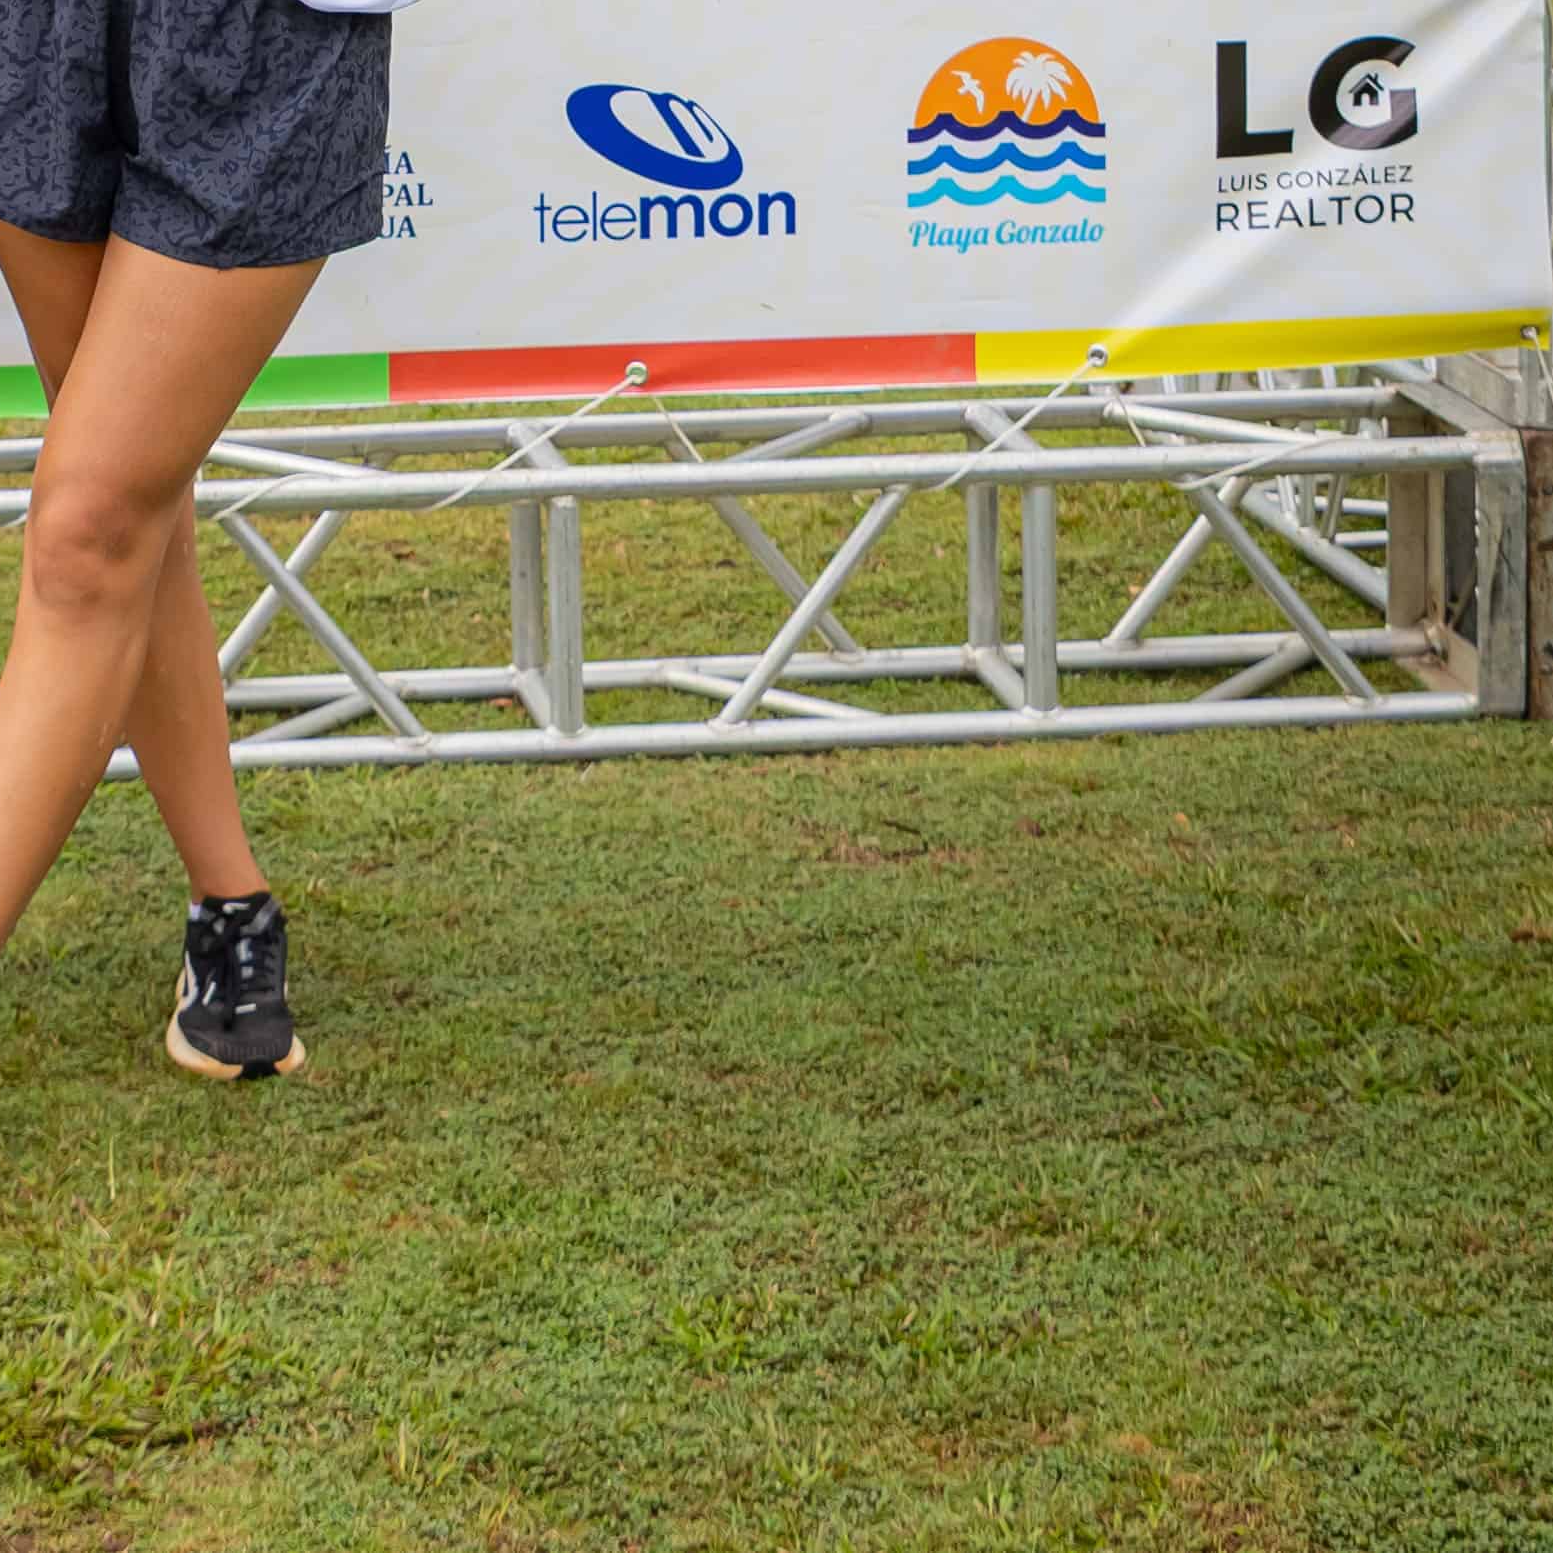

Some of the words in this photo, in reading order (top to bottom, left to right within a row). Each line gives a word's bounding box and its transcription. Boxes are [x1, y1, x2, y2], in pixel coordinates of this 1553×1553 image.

[1216, 171, 1269, 194] LUIS
[1275, 160, 1415, 192] GONZÁLEZ
[534, 190, 797, 245] telemon
[1215, 191, 1417, 235] REALTOR
[908, 218, 991, 255] Playa
[994, 214, 1107, 249] Gonzalo
